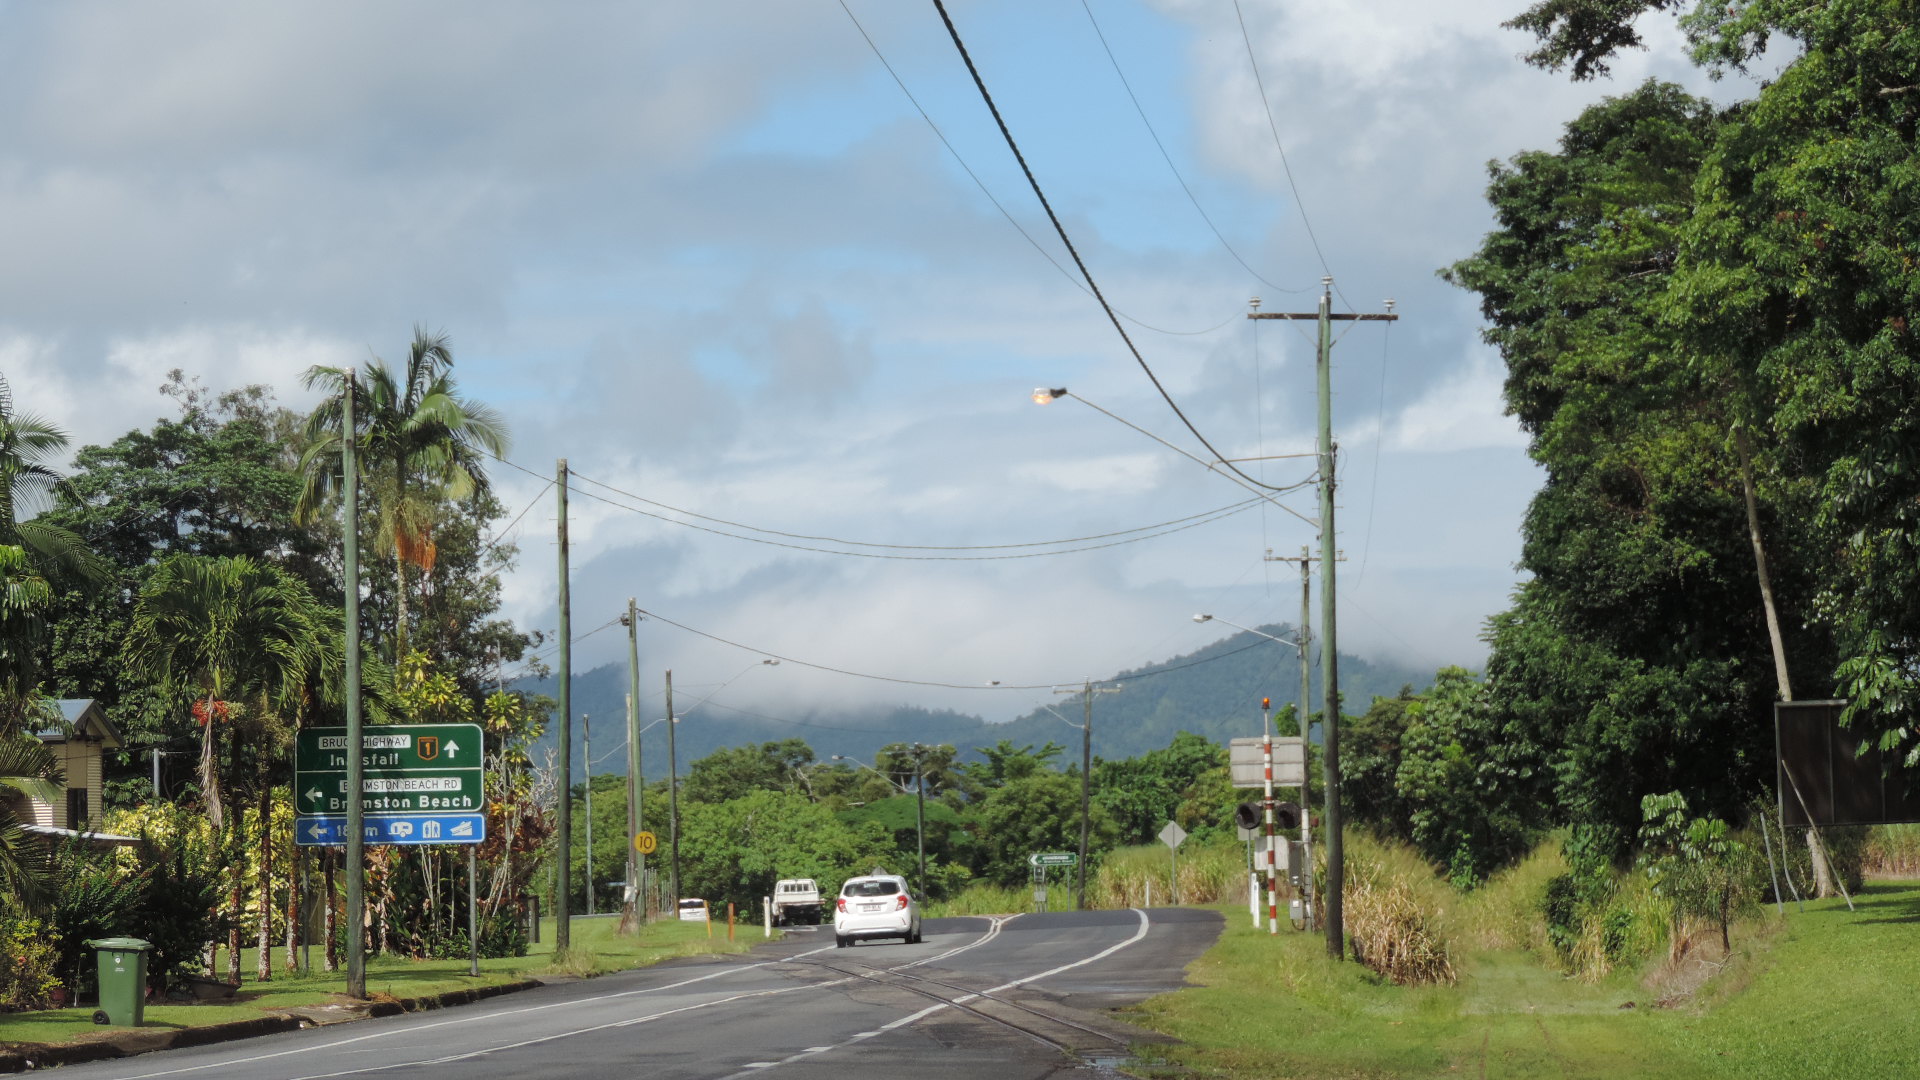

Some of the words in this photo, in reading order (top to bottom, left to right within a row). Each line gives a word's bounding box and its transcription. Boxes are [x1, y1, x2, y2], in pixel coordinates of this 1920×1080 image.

[322, 737, 348, 748] BRUC
[362, 736, 408, 747] HIGHWAY
[425, 742, 431, 756] 1
[330, 752, 399, 766] Insfail
[343, 780, 399, 792] BMSTON
[404, 780, 439, 790] BEACH
[444, 779, 458, 789] RD
[330, 796, 411, 810] Brmston
[419, 795, 472, 808] Beach
[639, 836, 653, 850] 10
